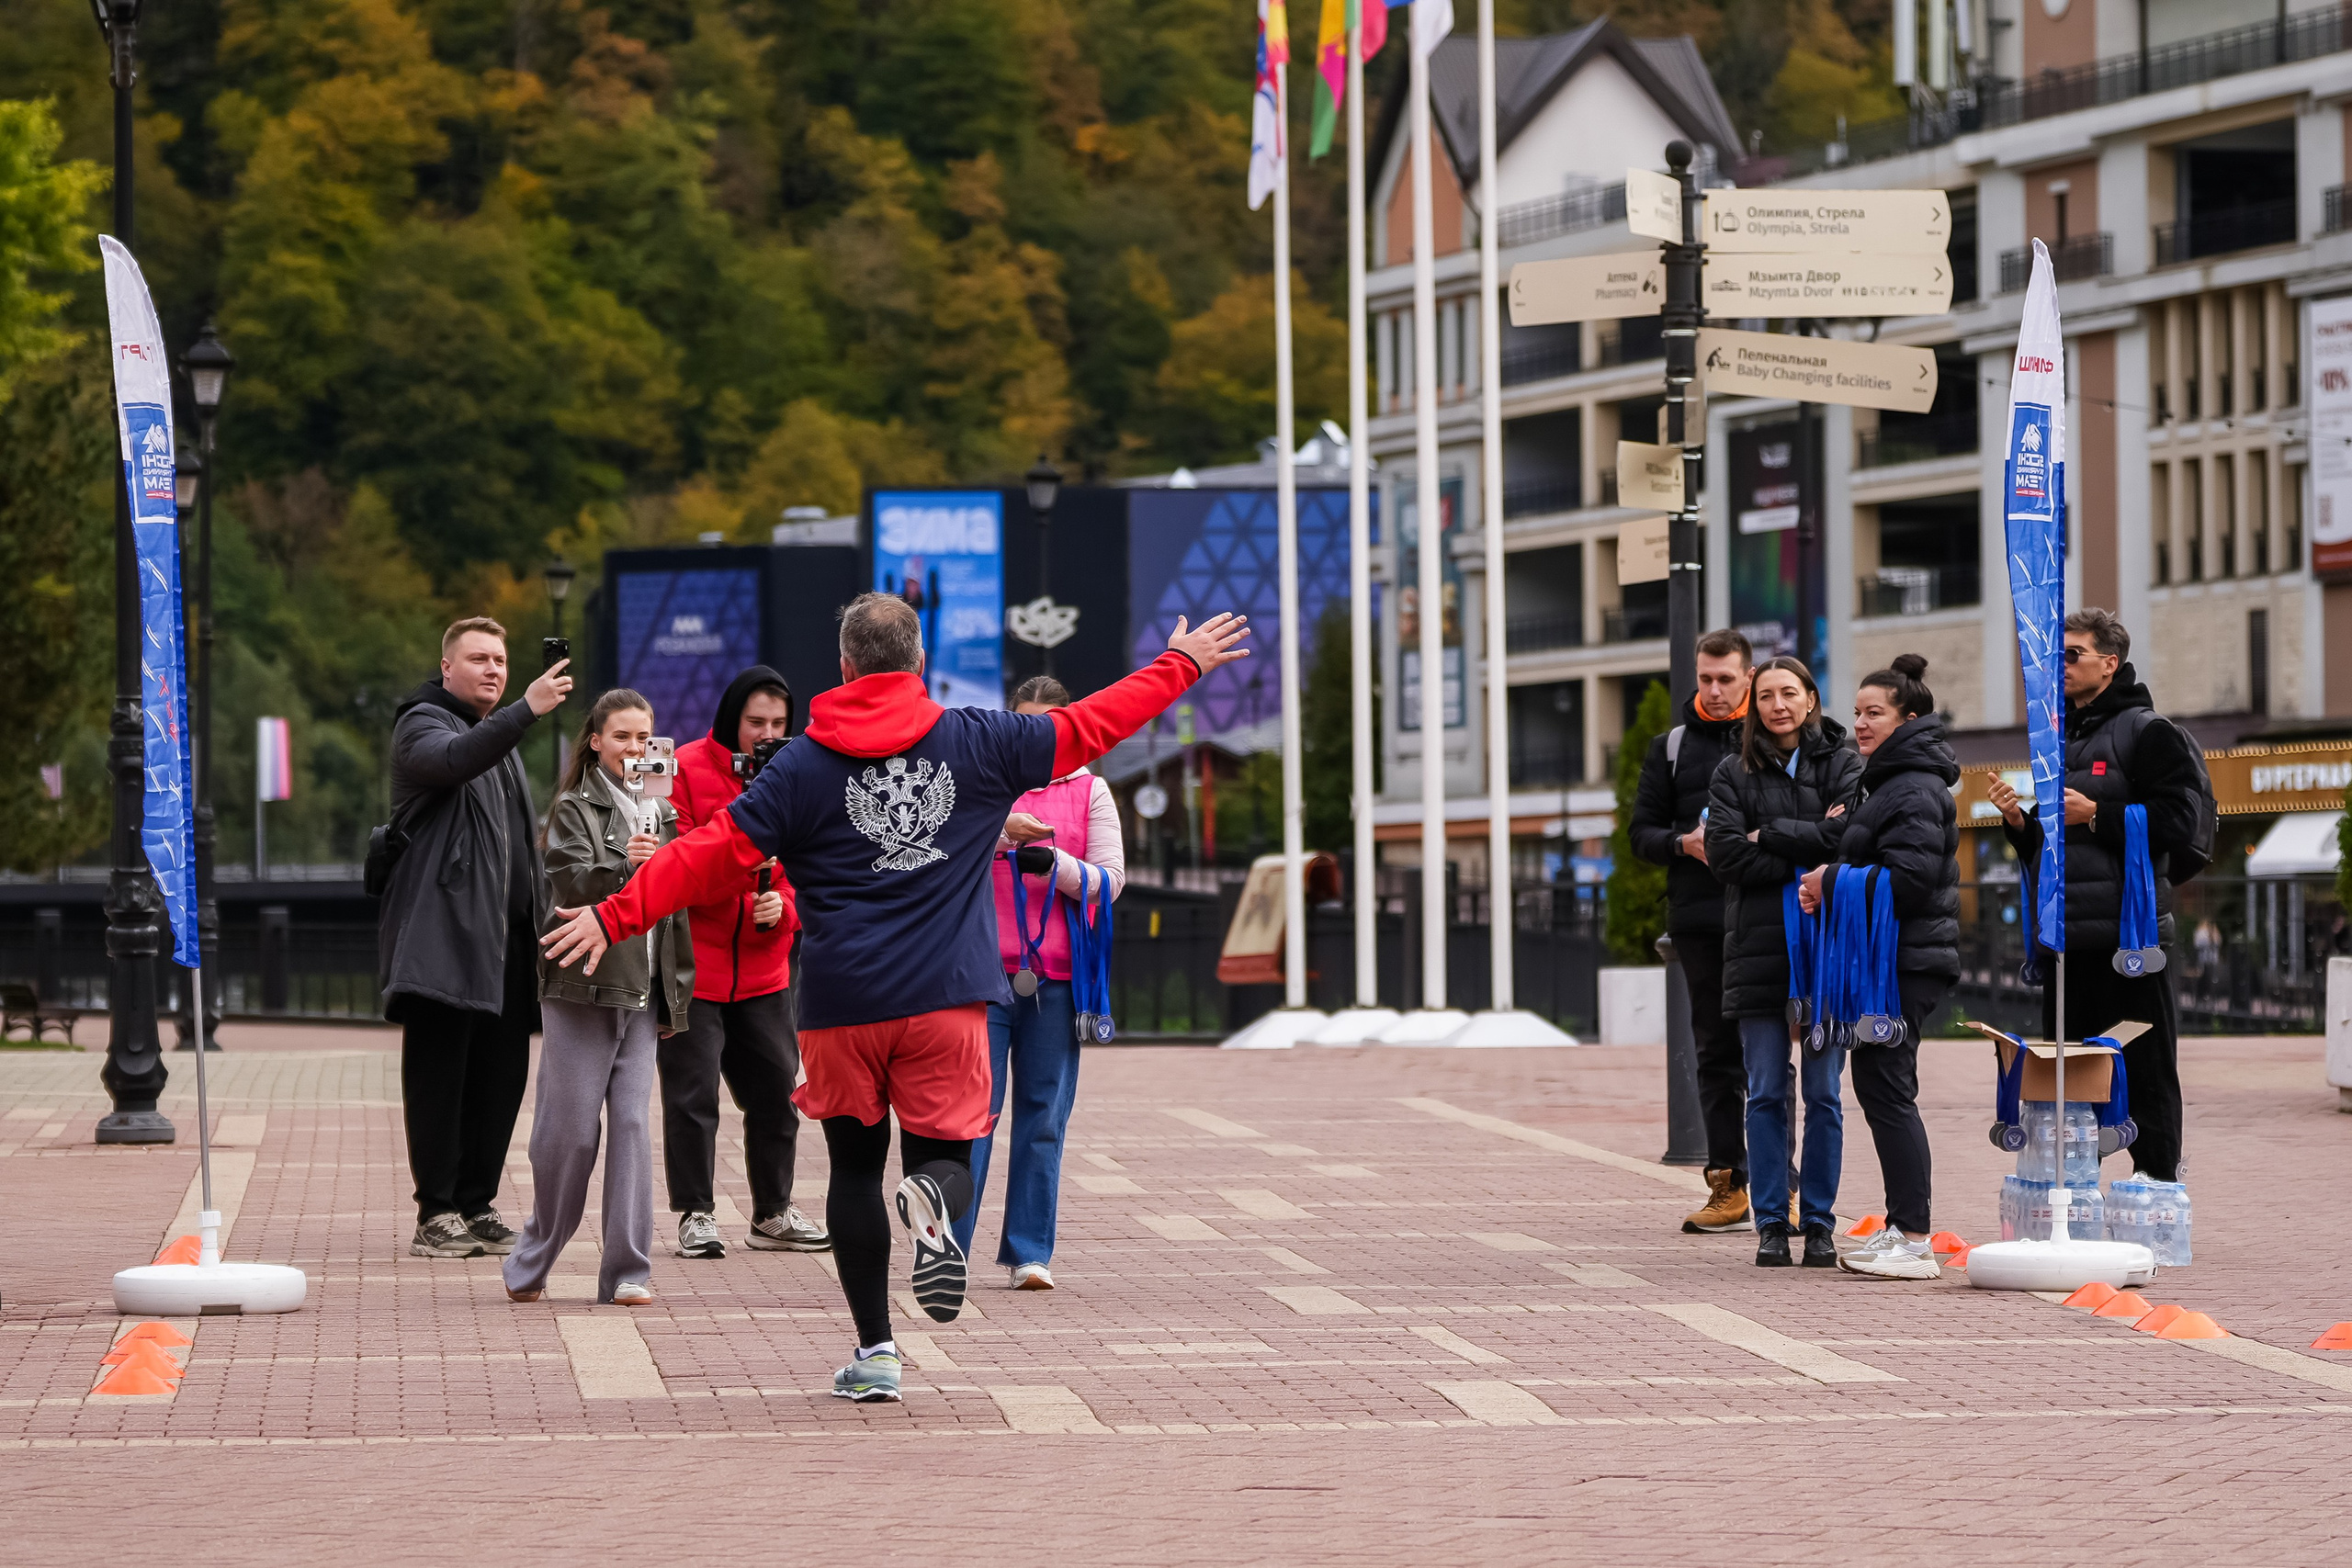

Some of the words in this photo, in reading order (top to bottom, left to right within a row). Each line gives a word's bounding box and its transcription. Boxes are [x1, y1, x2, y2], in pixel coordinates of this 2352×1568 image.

[1747, 207, 1814, 220] Олимпия,
[1817, 207, 1865, 220] Стрела
[1747, 221, 1806, 235] Olympia,
[1810, 221, 1849, 234] Strela
[1606, 272, 1638, 283] Аптека
[1748, 271, 1803, 282] Мзымта
[1806, 270, 1841, 283] Двор
[1595, 287, 1638, 300] Pharmacy
[1748, 287, 1800, 299] Mzymta
[1804, 287, 1834, 297] Dvor
[1738, 347, 1827, 367] Пеленальная
[1737, 364, 1770, 380] Baby
[1773, 367, 1833, 387] Changing
[1836, 373, 1892, 390] facilities
